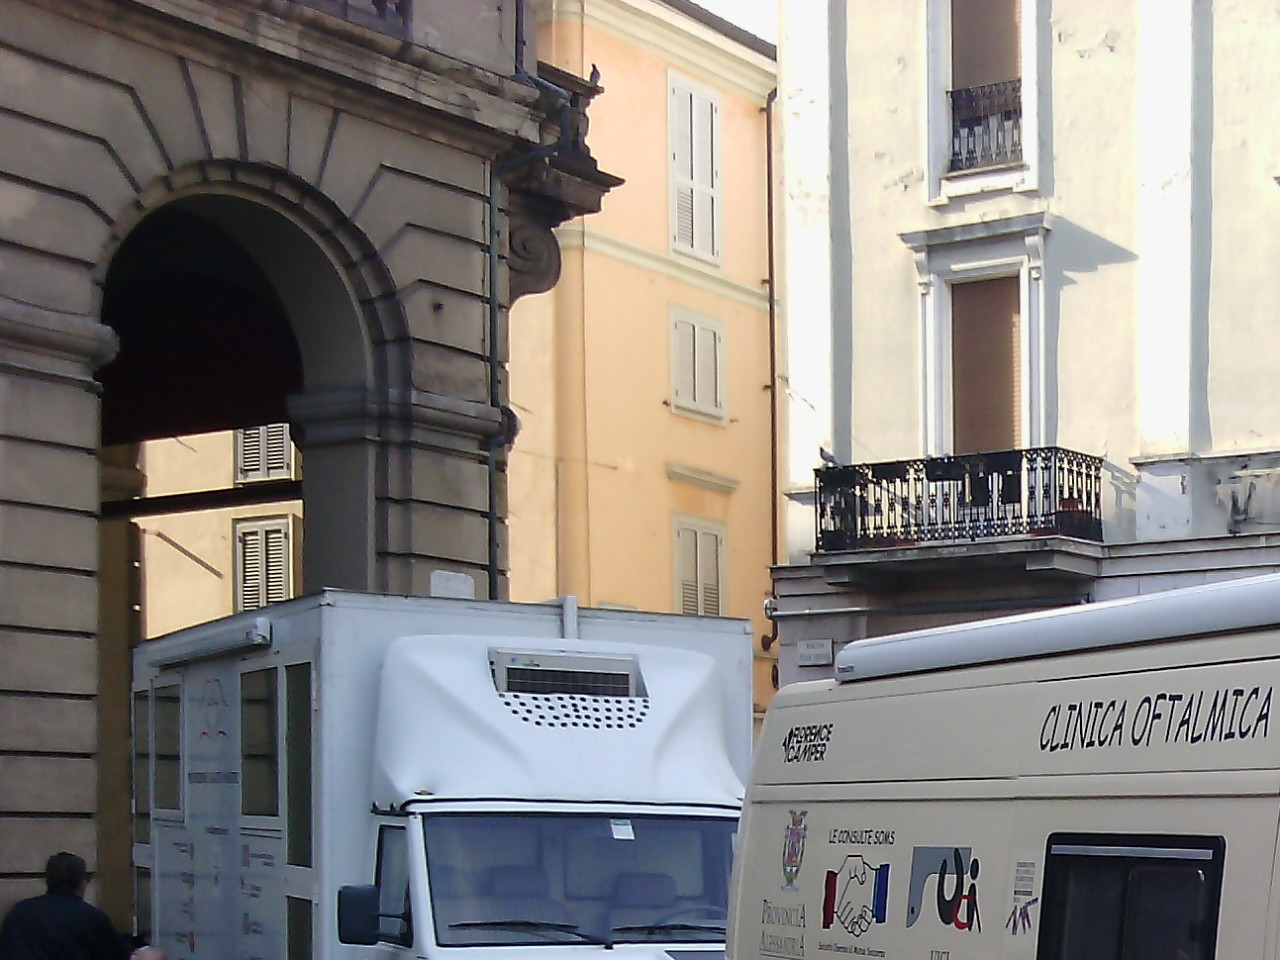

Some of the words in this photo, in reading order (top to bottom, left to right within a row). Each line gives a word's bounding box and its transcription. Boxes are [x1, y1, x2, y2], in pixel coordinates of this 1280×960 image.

[1038, 698, 1126, 753] CLINICA
[1131, 686, 1273, 748] OFTALMICA
[787, 743, 827, 763] CAMPER
